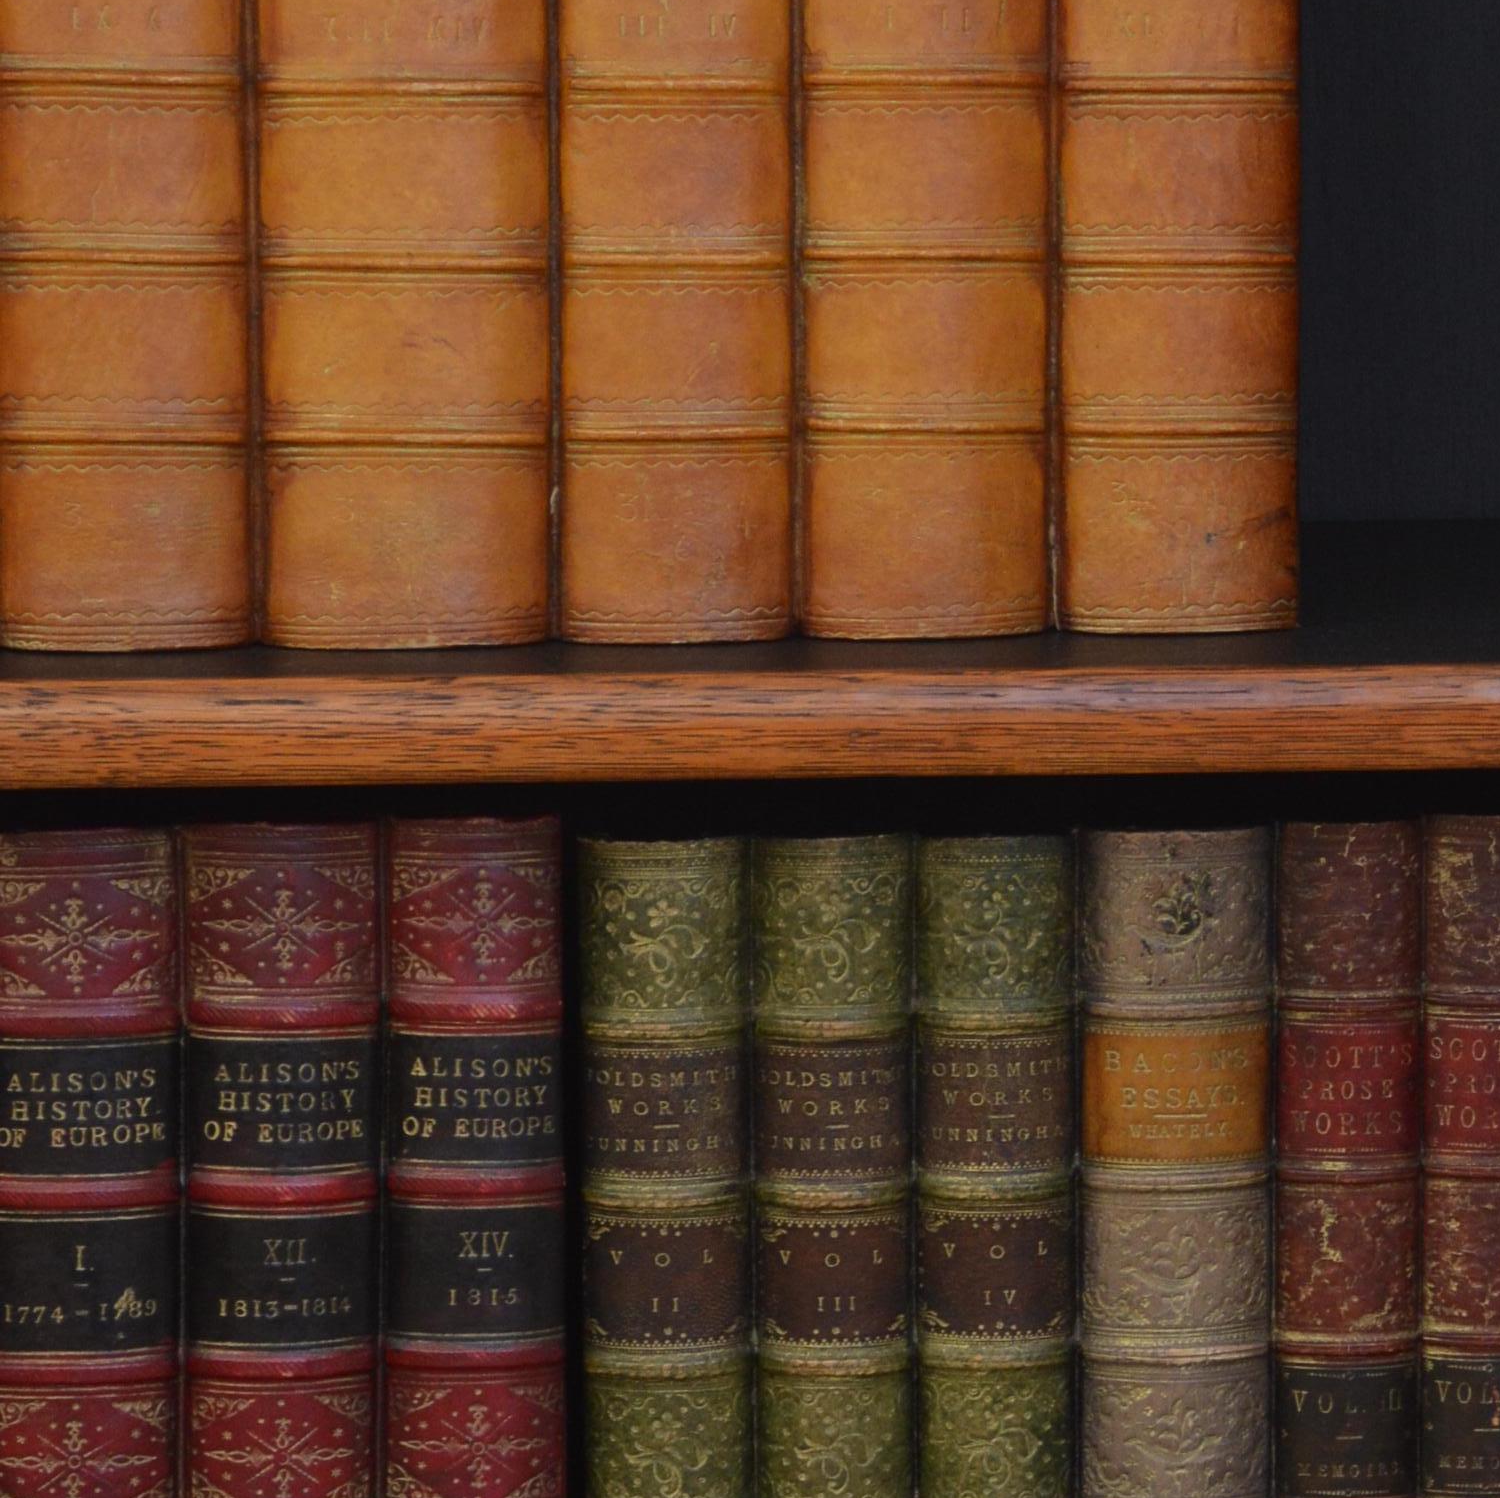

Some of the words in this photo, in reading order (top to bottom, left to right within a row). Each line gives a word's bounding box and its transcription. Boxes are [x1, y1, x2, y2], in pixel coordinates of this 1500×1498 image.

[410, 1056, 552, 1079] ALISON'S
[1285, 1044, 1413, 1069] SCOTT'S
[214, 1061, 361, 1083] ALISON'S
[587, 1066, 737, 1088] OLDSMITH
[763, 1068, 894, 1088] OLDSMIT
[924, 1058, 1065, 1080] OLDSMITH
[6, 1068, 157, 1093] ALISON'S
[1299, 1077, 1395, 1102] PROSE
[219, 1088, 356, 1112] HISTORY
[413, 1085, 548, 1109] HISTORY
[608, 1095, 722, 1117] WORKS
[778, 1096, 890, 1117] WORKS
[942, 1087, 1053, 1107] WORKS
[204, 1120, 237, 1142] OF
[258, 1118, 364, 1143] EUROPE
[402, 1115, 437, 1138] OF
[453, 1115, 556, 1139] EUROPE
[1290, 1109, 1403, 1137] WORKS
[0, 1127, 27, 1149] OF
[49, 1121, 166, 1148] EUROPE
[588, 1134, 735, 1153] UNNINGH
[763, 1133, 899, 1153] UNNINGH
[924, 1125, 1064, 1145] UNNINGHA
